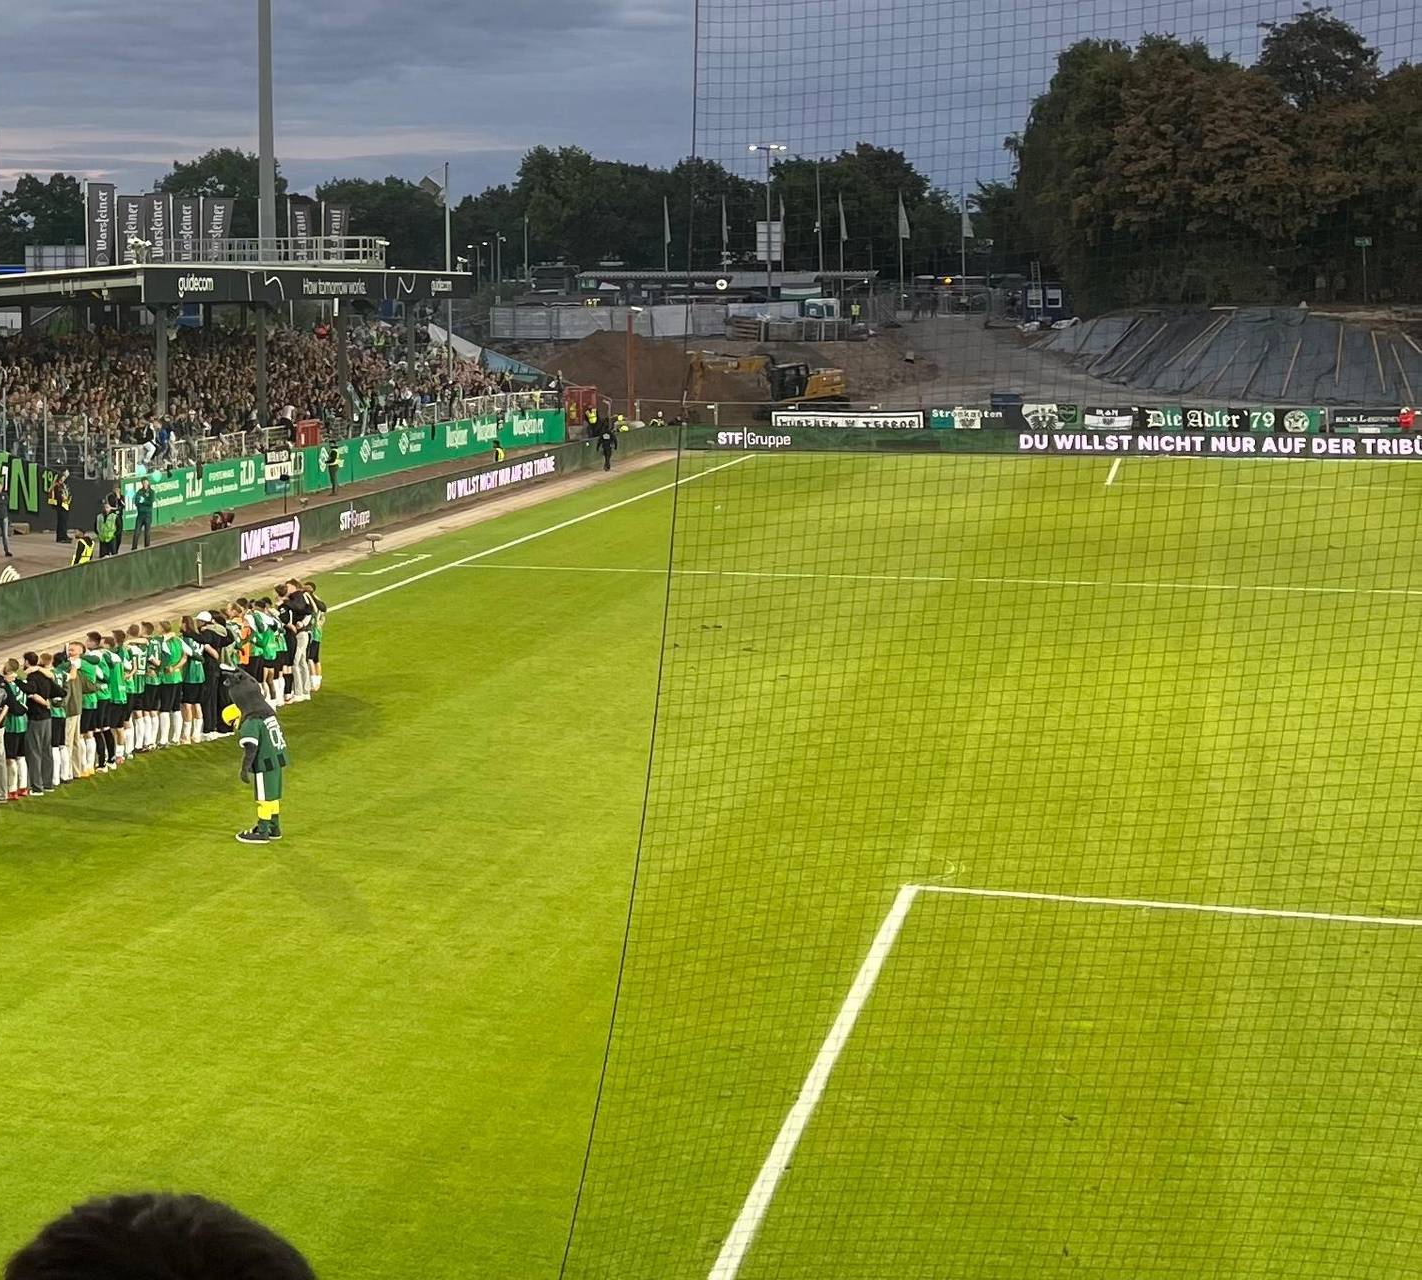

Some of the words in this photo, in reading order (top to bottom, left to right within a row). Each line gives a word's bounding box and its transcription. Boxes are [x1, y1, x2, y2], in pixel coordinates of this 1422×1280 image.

[95, 190, 110, 252] Warsteiner
[152, 200, 163, 259] Warsteiner
[178, 275, 213, 298] guidecom
[1145, 409, 1182, 427] Die
[1187, 409, 1241, 428] Adler
[718, 431, 743, 445] STF
[747, 432, 791, 448] Gruppe
[1019, 434, 1048, 450] DU
[1054, 434, 1132, 451] WILLST
[1138, 435, 1204, 451] NICHT
[1211, 436, 1257, 452] NUR
[1262, 437, 1306, 453] AUF
[1312, 438, 1356, 454] DER
